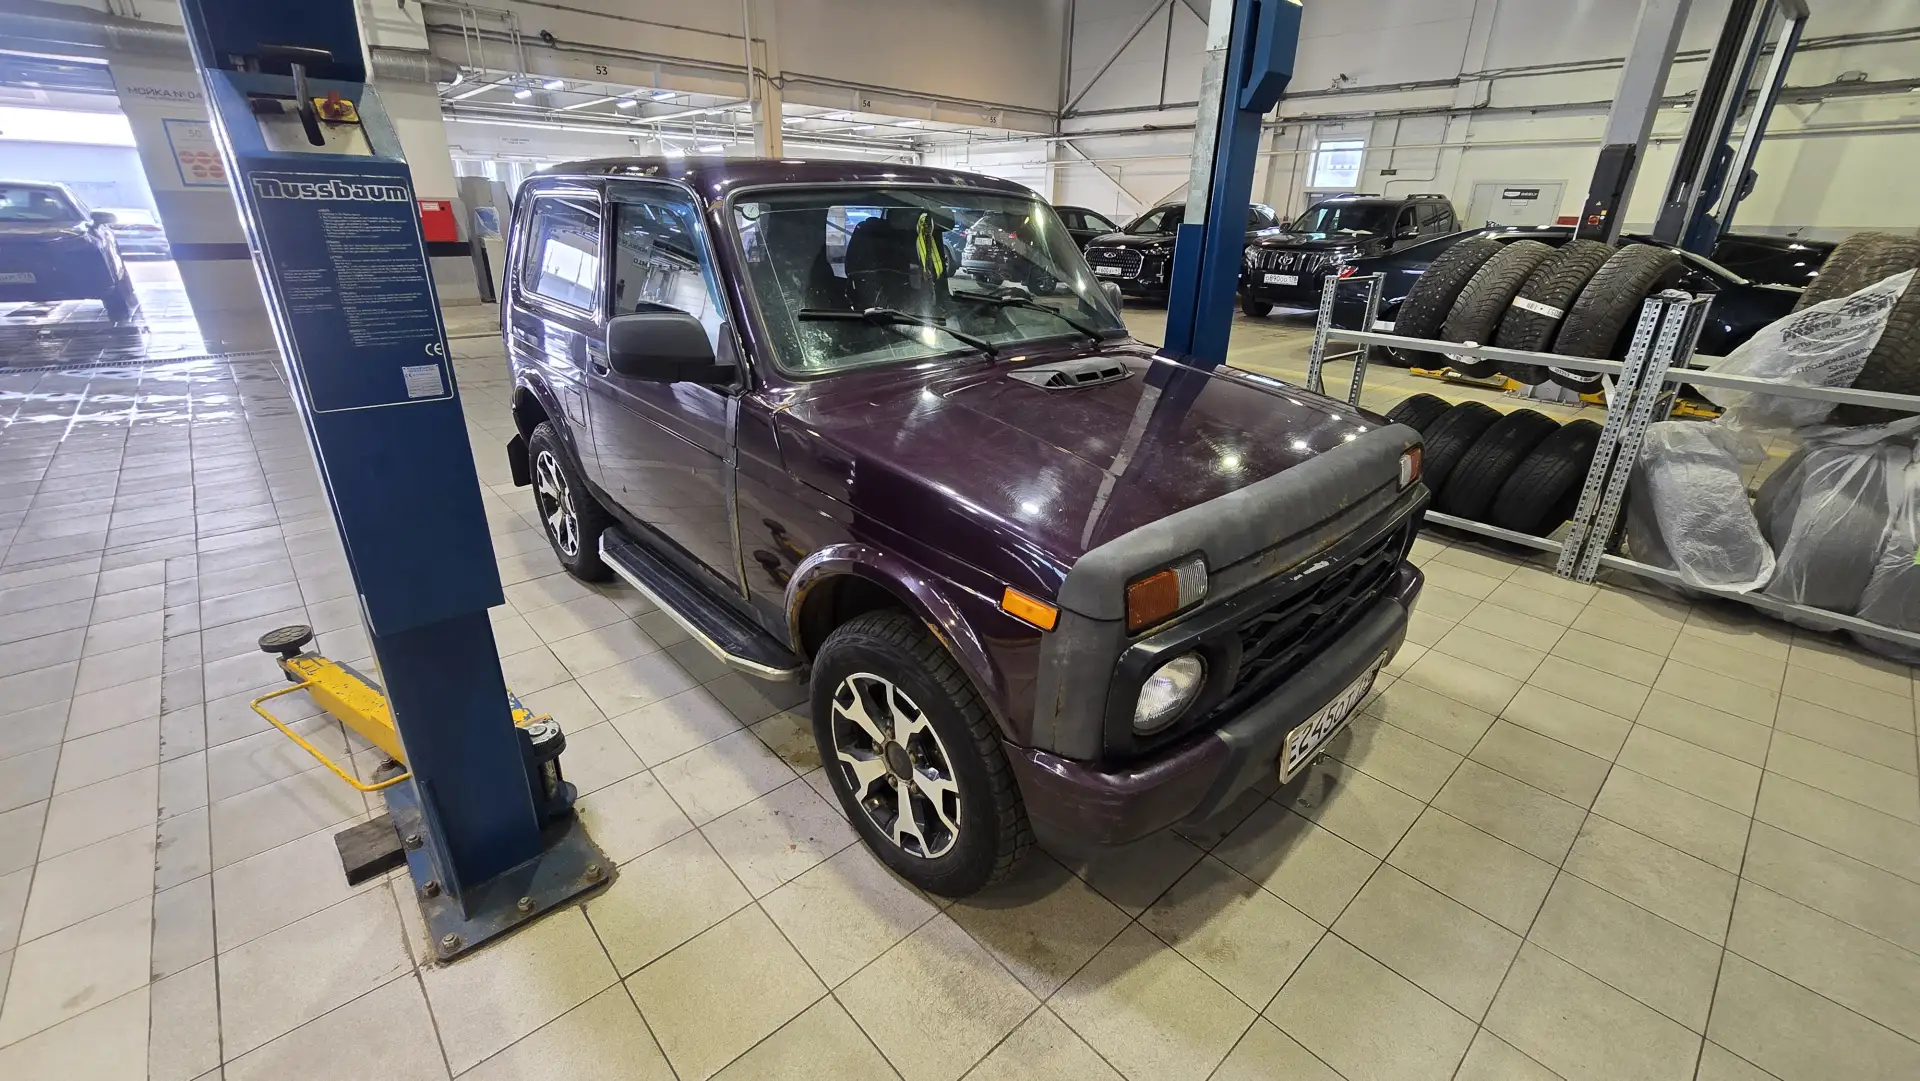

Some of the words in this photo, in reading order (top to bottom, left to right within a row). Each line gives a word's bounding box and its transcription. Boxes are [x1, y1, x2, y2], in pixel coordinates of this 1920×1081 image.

[595, 65, 608, 75] 53
[862, 100, 871, 108] 54
[425, 343, 443, 356] CE
